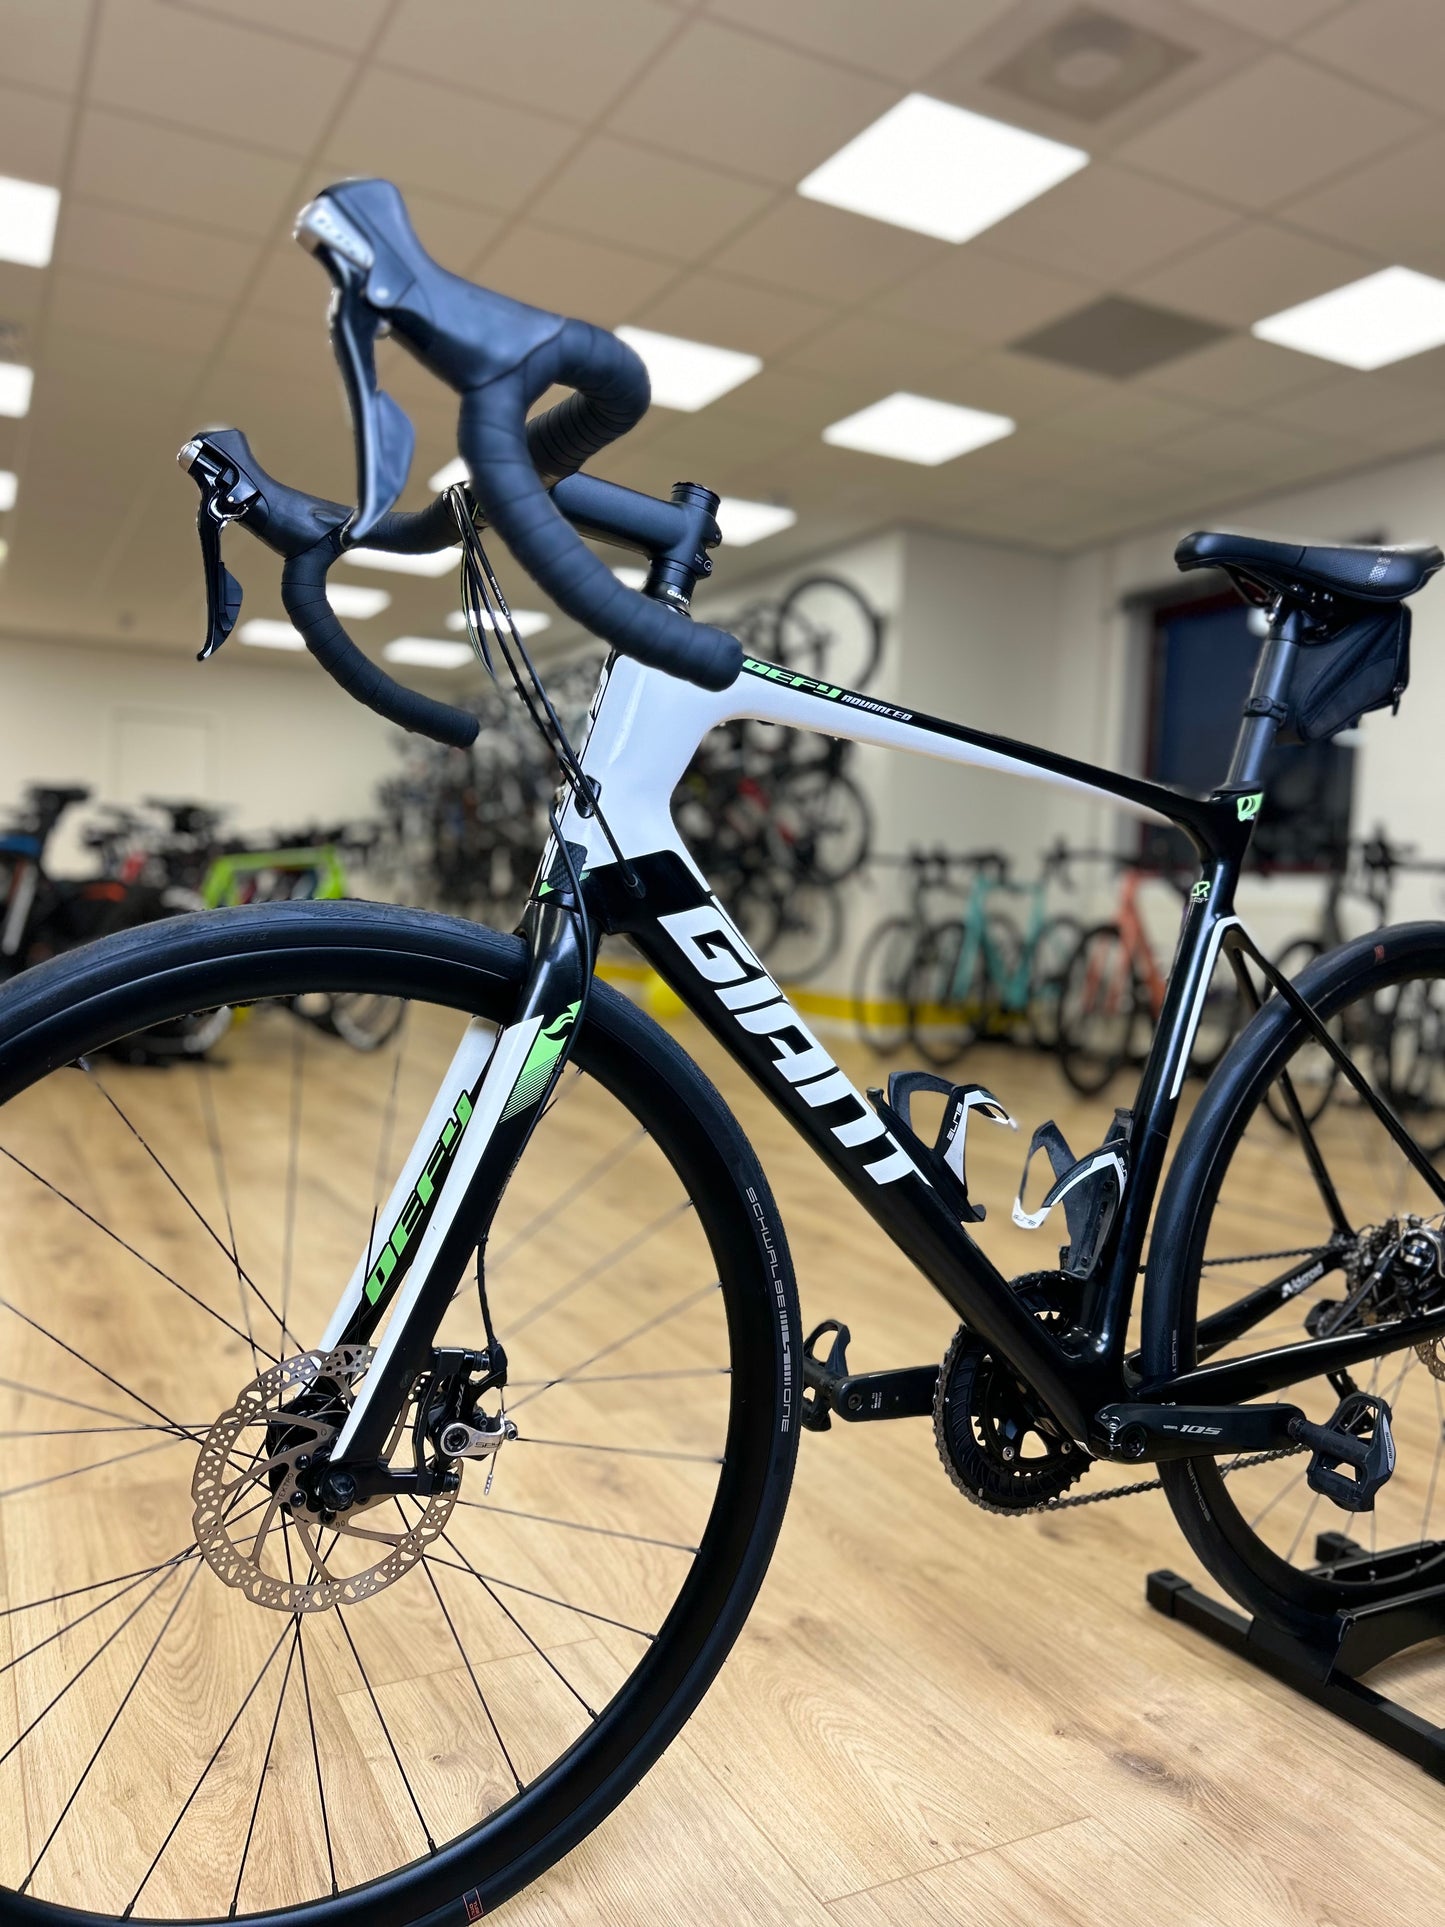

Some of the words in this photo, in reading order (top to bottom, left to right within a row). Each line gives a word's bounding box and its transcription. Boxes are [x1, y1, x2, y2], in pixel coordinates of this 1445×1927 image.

[667, 589, 690, 605] GIANT
[742, 659, 843, 699] DEFY
[841, 694, 913, 722] ADVANCED
[656, 904, 934, 1189] GIANT
[364, 1089, 474, 1307] DEFY
[745, 1186, 788, 1308] SCHWALBE
[780, 1387, 793, 1433] ONE
[1179, 1424, 1224, 1436] 105
[276, 1472, 295, 1501] TEKTRO
